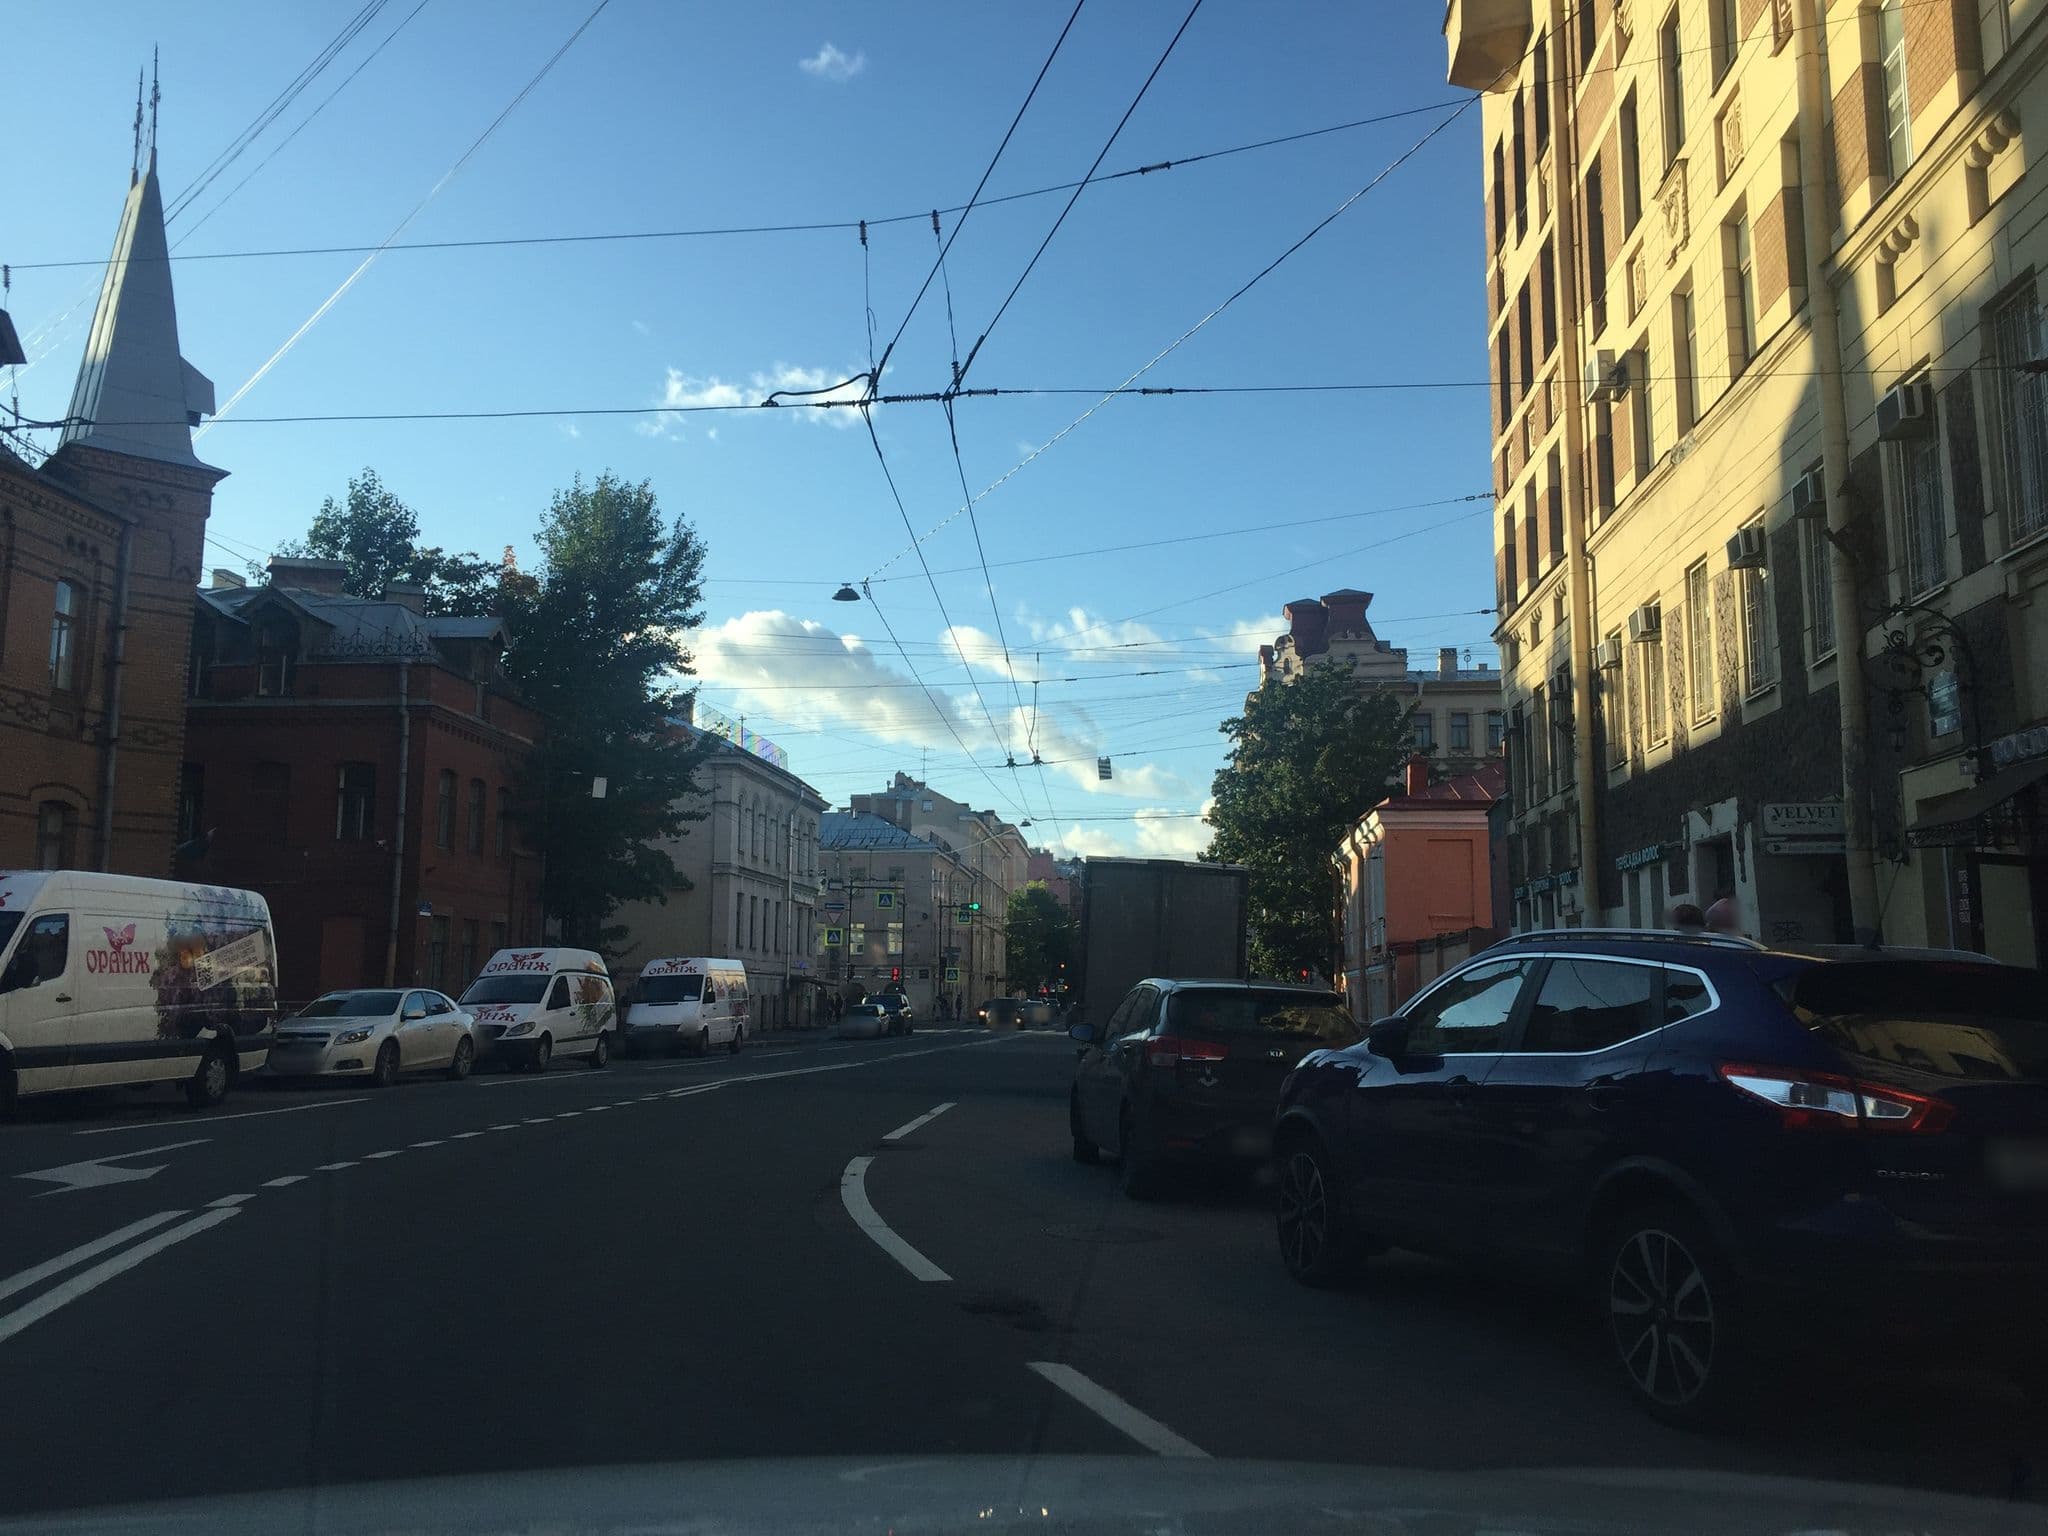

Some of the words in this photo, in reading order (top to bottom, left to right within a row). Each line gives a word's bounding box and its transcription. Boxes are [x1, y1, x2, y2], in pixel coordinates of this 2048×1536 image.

[1773, 806, 1840, 819] VELVET
[86, 949, 151, 974] ОРАНЖ
[486, 961, 552, 973] ОРАНЖ
[648, 965, 698, 975] ОРАНЖ
[1268, 1050, 1285, 1058] KIA
